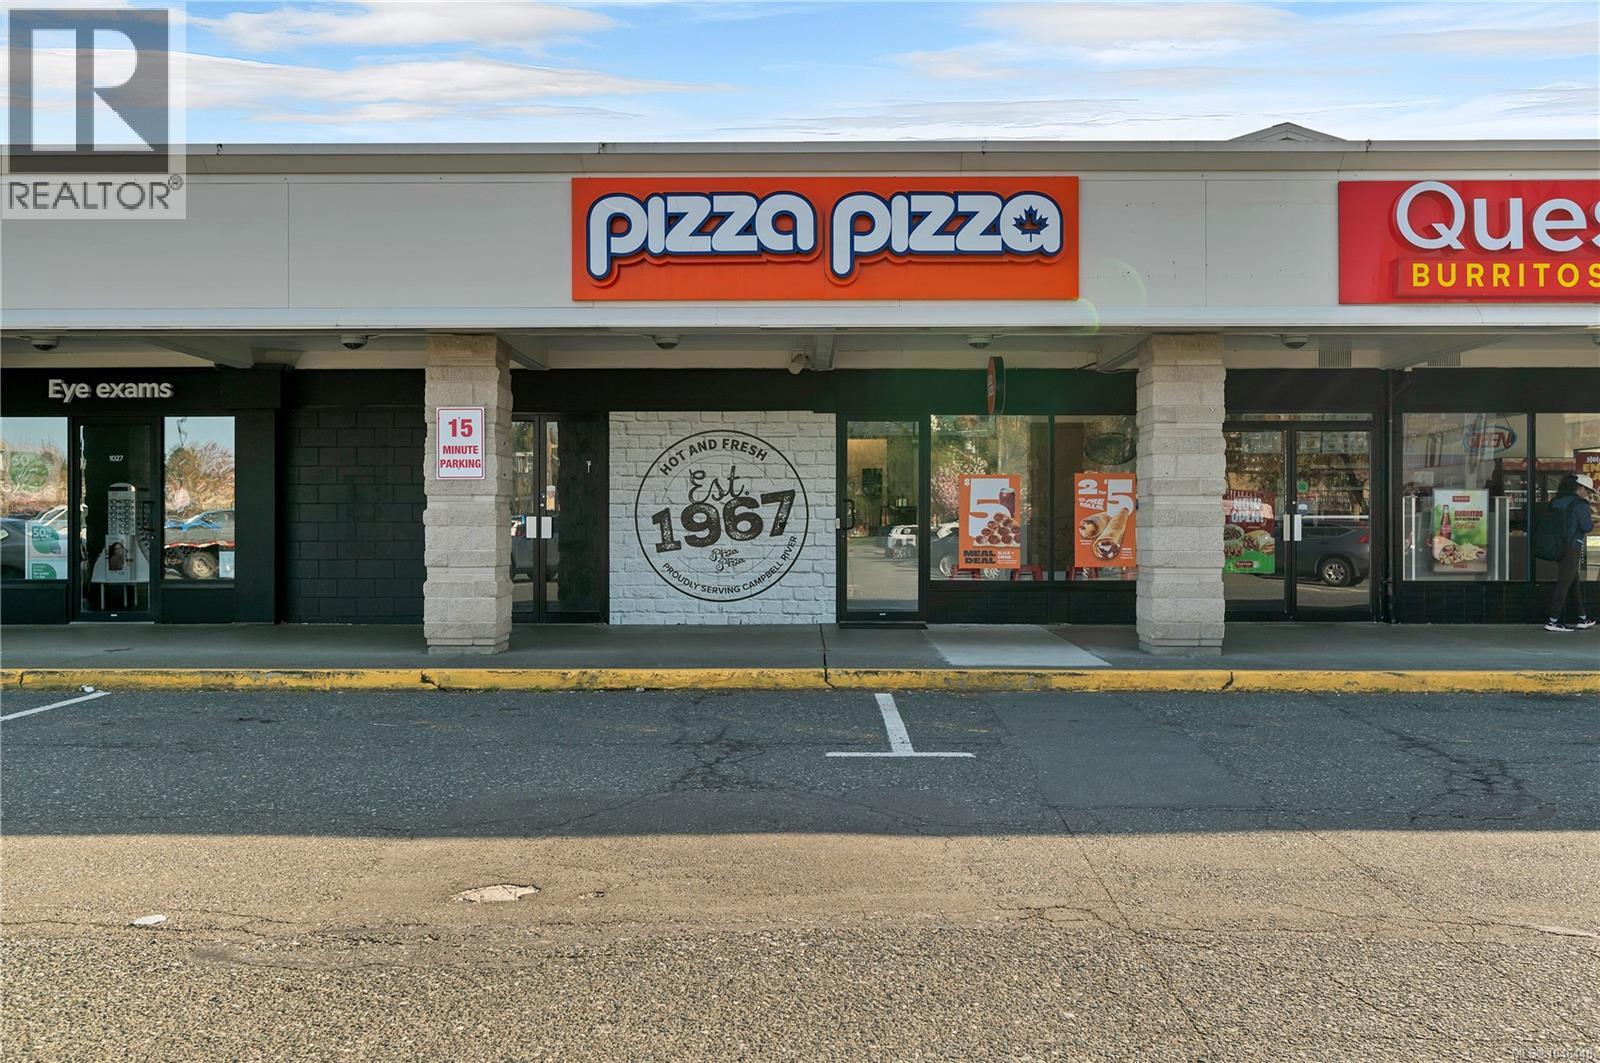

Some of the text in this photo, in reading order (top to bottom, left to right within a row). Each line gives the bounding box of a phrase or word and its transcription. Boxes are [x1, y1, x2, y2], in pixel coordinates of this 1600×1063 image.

[1396, 181, 1600, 252] Que
[1412, 263, 1600, 288] BURRITOS
[48, 379, 174, 403] Eye exams
[448, 418, 473, 438] 15
[108, 455, 124, 463] 1027
[442, 445, 479, 455] MINUTE
[659, 438, 769, 477] HOT AND FRESH
[440, 459, 481, 469] PARKING
[688, 465, 750, 505] Est.
[1078, 479, 1098, 494] 2
[651, 489, 796, 553] 1967
[963, 549, 996, 557] MEAL
[965, 557, 996, 565] DEAL
[662, 535, 798, 595] PROUDLY SERVING CAMPBELL RIVER
